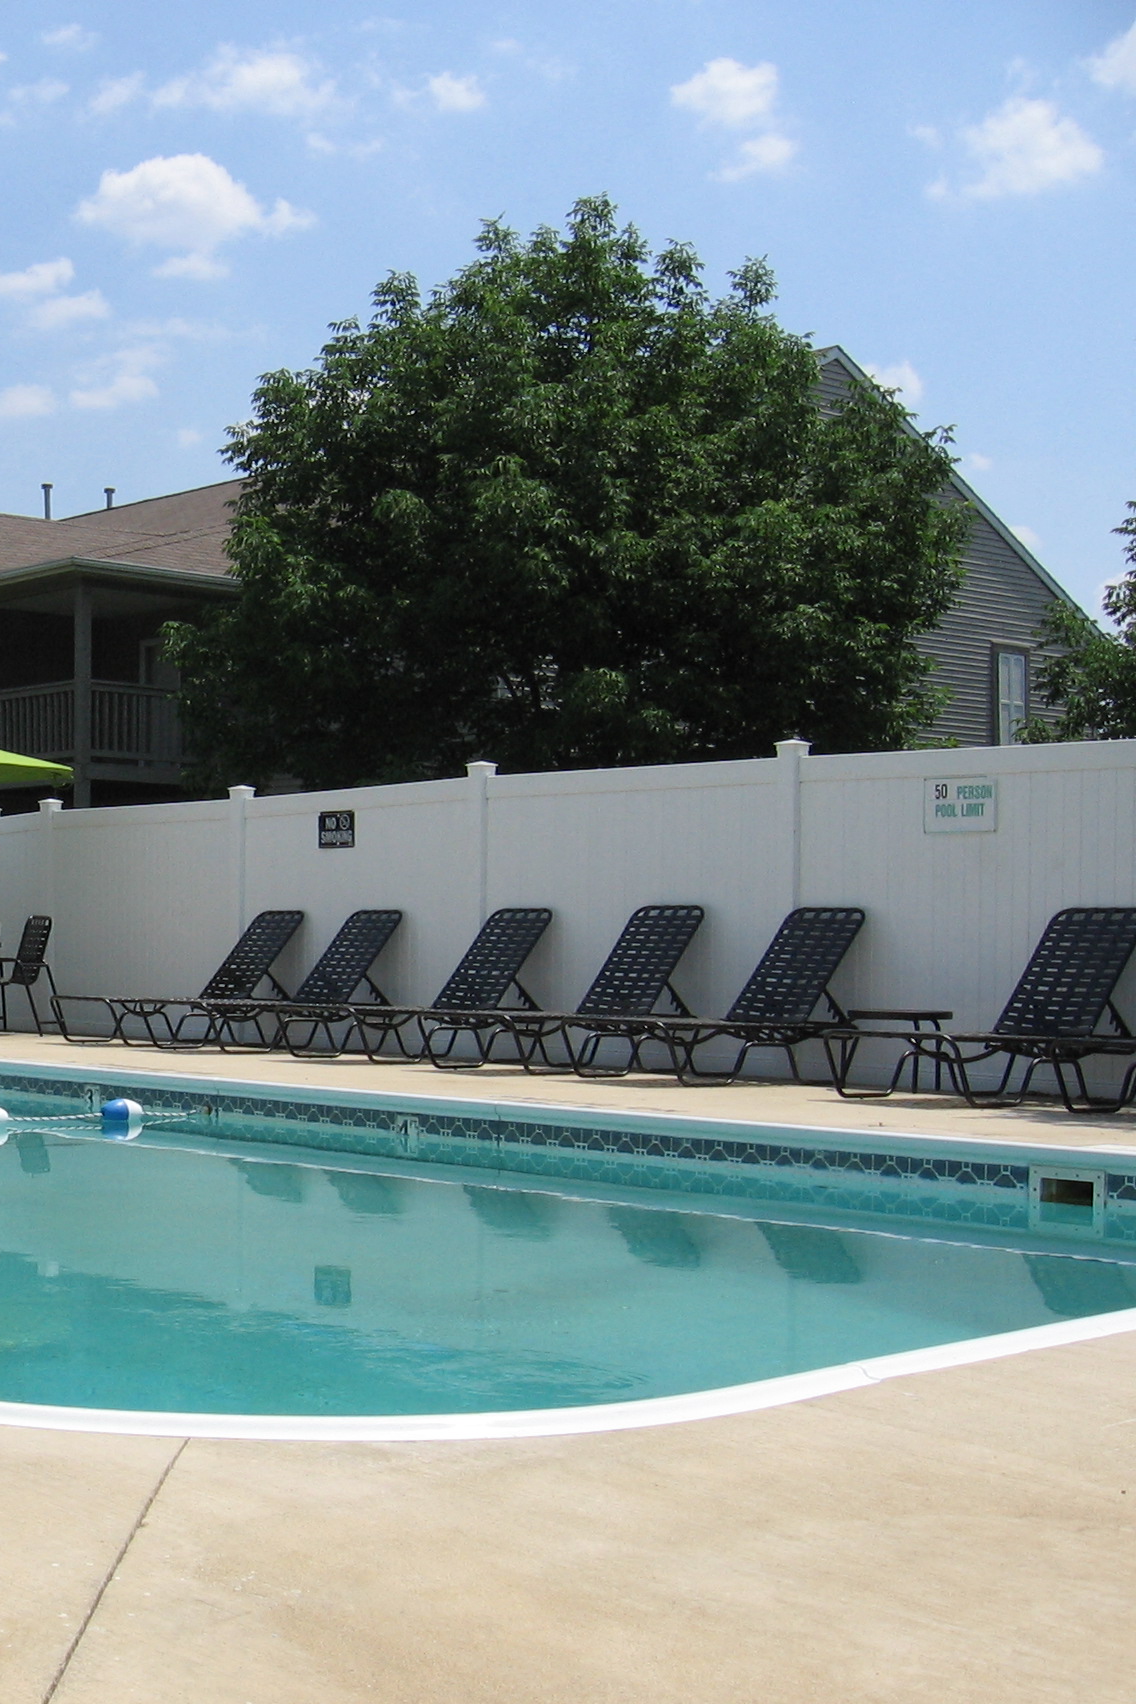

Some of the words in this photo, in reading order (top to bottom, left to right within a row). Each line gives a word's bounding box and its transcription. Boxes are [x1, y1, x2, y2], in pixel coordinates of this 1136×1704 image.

[935, 784, 948, 800] 50
[957, 785, 993, 800] PERSON
[935, 803, 958, 818] POOL
[961, 803, 985, 817] LIMIT
[325, 816, 337, 830] NO
[321, 830, 353, 843] SMOKING
